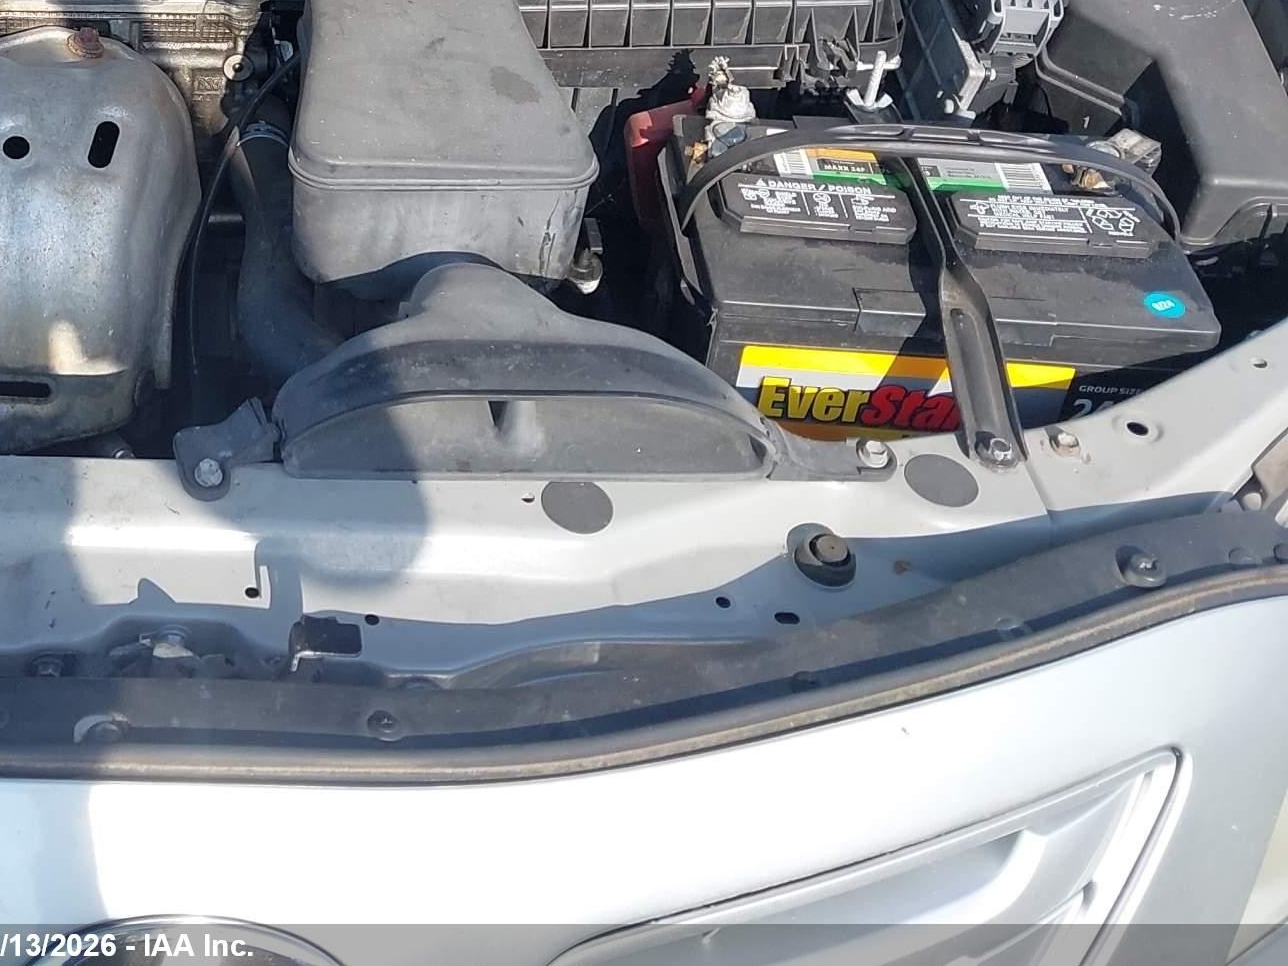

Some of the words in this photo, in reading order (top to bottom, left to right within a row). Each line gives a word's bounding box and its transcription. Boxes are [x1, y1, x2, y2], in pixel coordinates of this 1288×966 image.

[768, 180, 817, 191] DANGER
[828, 184, 872, 195] POISON
[1079, 385, 1118, 395] GROUP
